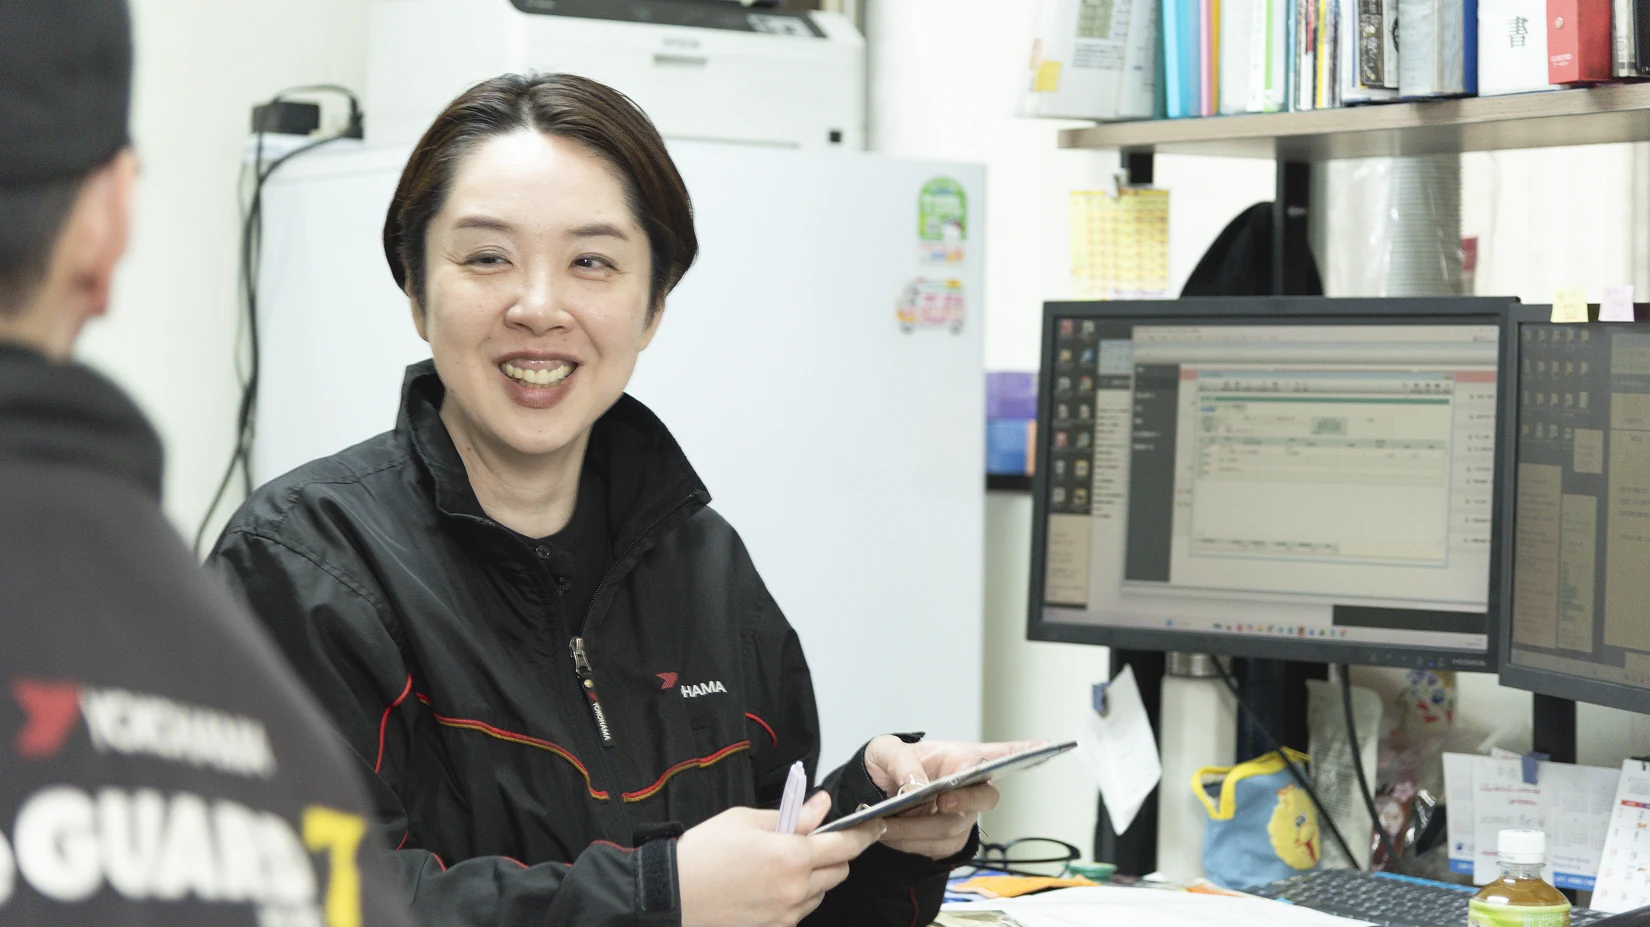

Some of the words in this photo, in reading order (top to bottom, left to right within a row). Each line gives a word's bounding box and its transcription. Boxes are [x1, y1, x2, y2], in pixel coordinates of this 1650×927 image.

[1507, 16, 1528, 48] 書
[680, 680, 728, 698] HAMA
[592, 701, 612, 741] YOKOHAMA
